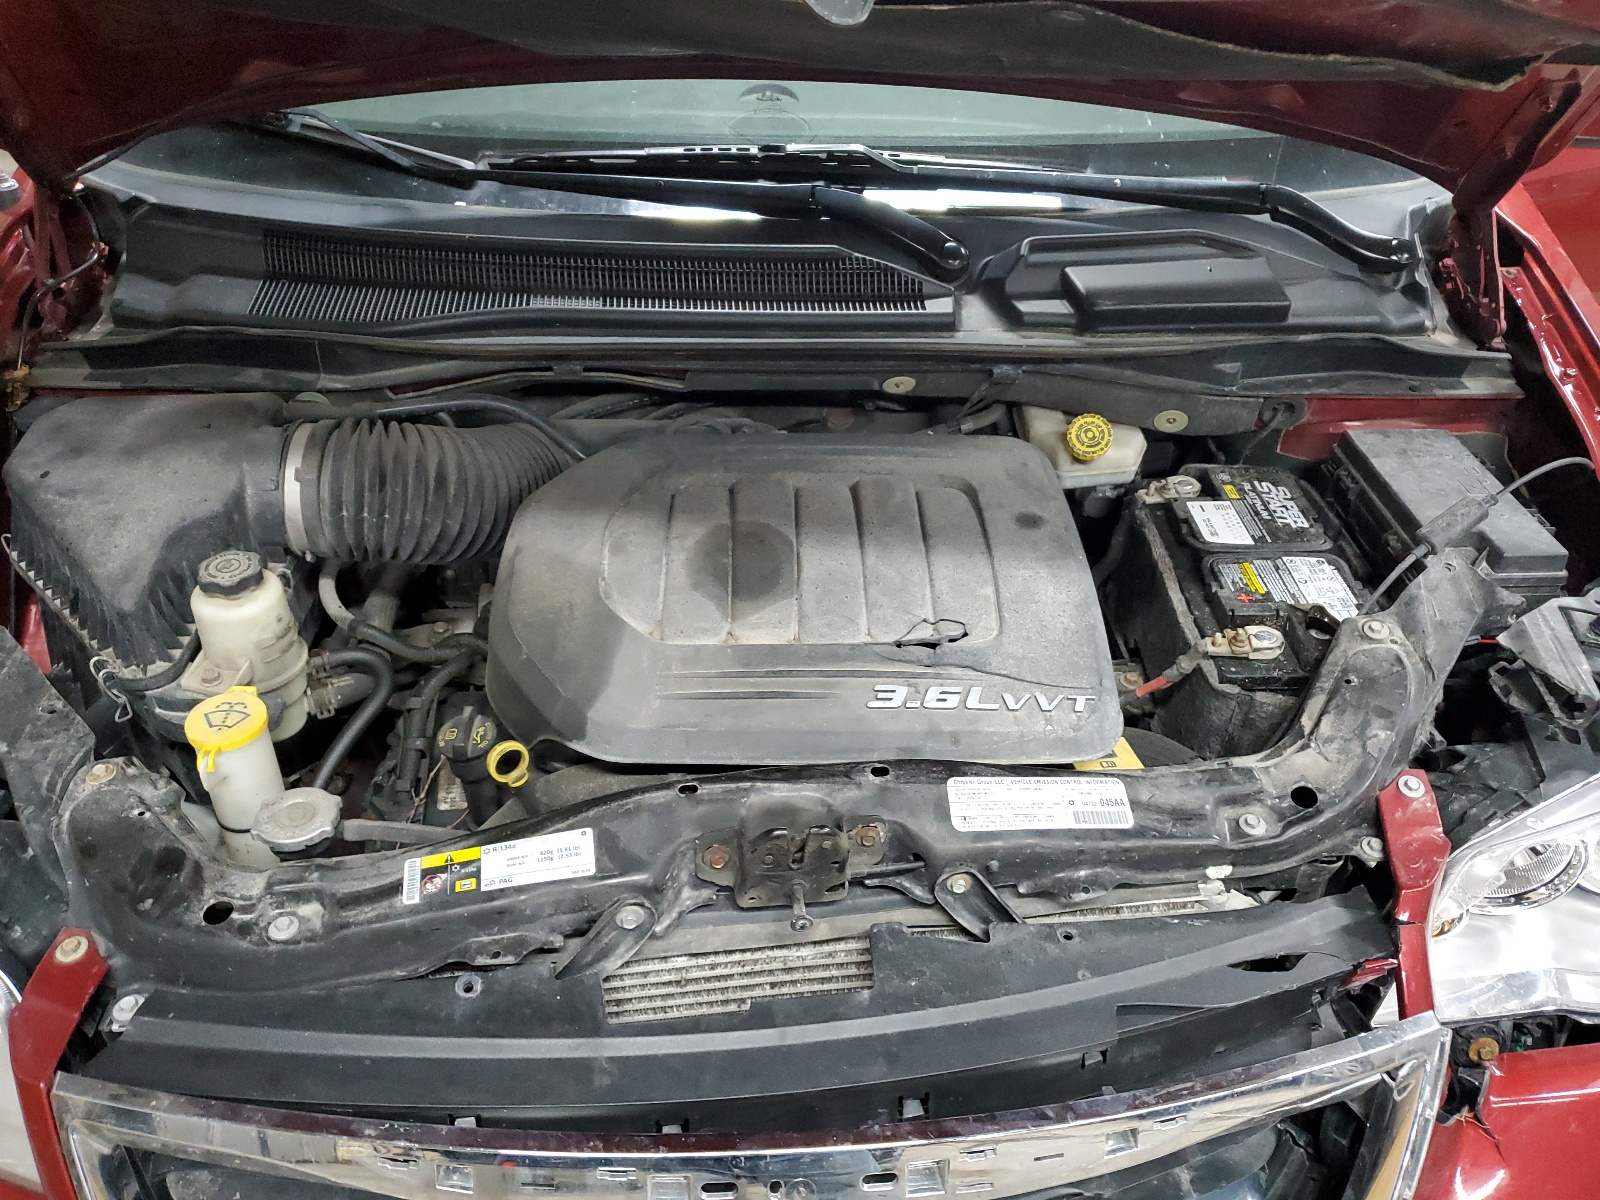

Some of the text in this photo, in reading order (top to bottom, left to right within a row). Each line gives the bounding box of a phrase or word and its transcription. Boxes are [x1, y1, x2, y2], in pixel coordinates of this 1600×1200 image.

[1241, 481, 1272, 520] PLATINUM
[1253, 480, 1298, 529] START
[1277, 486, 1310, 528] SUPER
[1099, 797, 1126, 807] 045AA
[492, 843, 517, 853] R-134a
[498, 876, 513, 885] PAG
